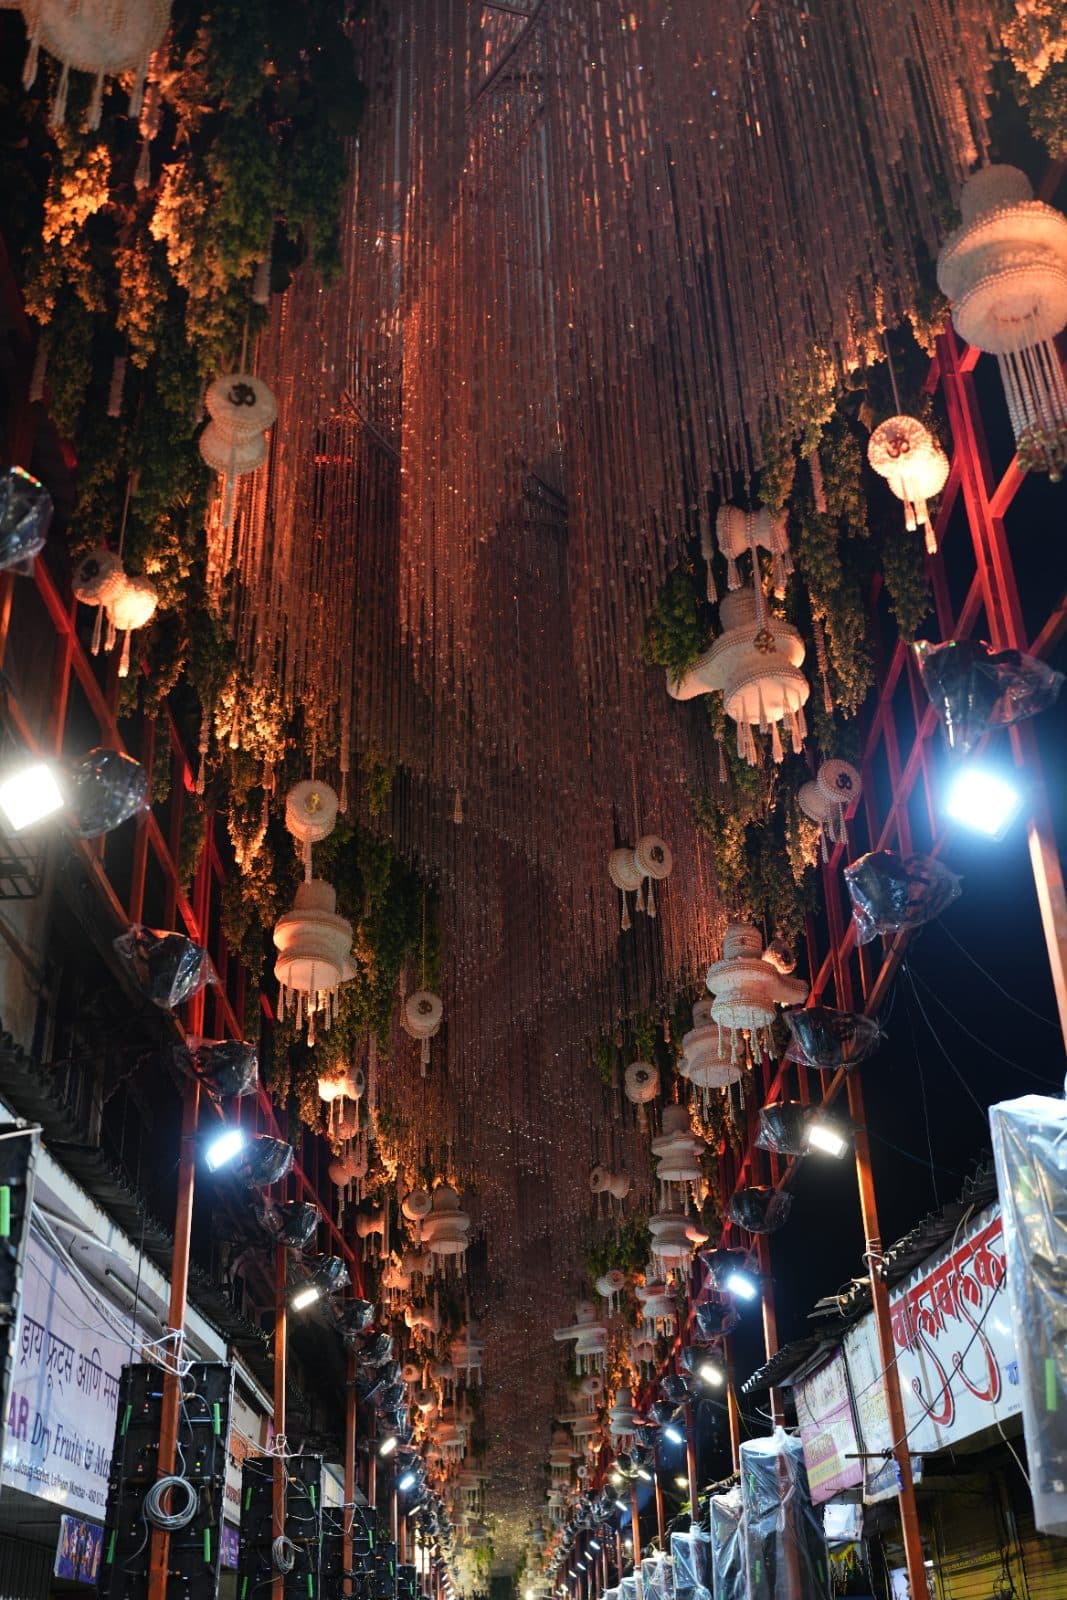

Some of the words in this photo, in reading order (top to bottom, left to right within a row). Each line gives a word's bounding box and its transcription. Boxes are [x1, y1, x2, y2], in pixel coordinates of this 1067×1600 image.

[20, 1313, 46, 1369] ड्राय
[76, 1347, 103, 1401] आणि
[8, 1391, 29, 1442] AR
[31, 1412, 52, 1463] Dry
[53, 1423, 83, 1467] Fruits
[94, 1445, 110, 1478] Ma
